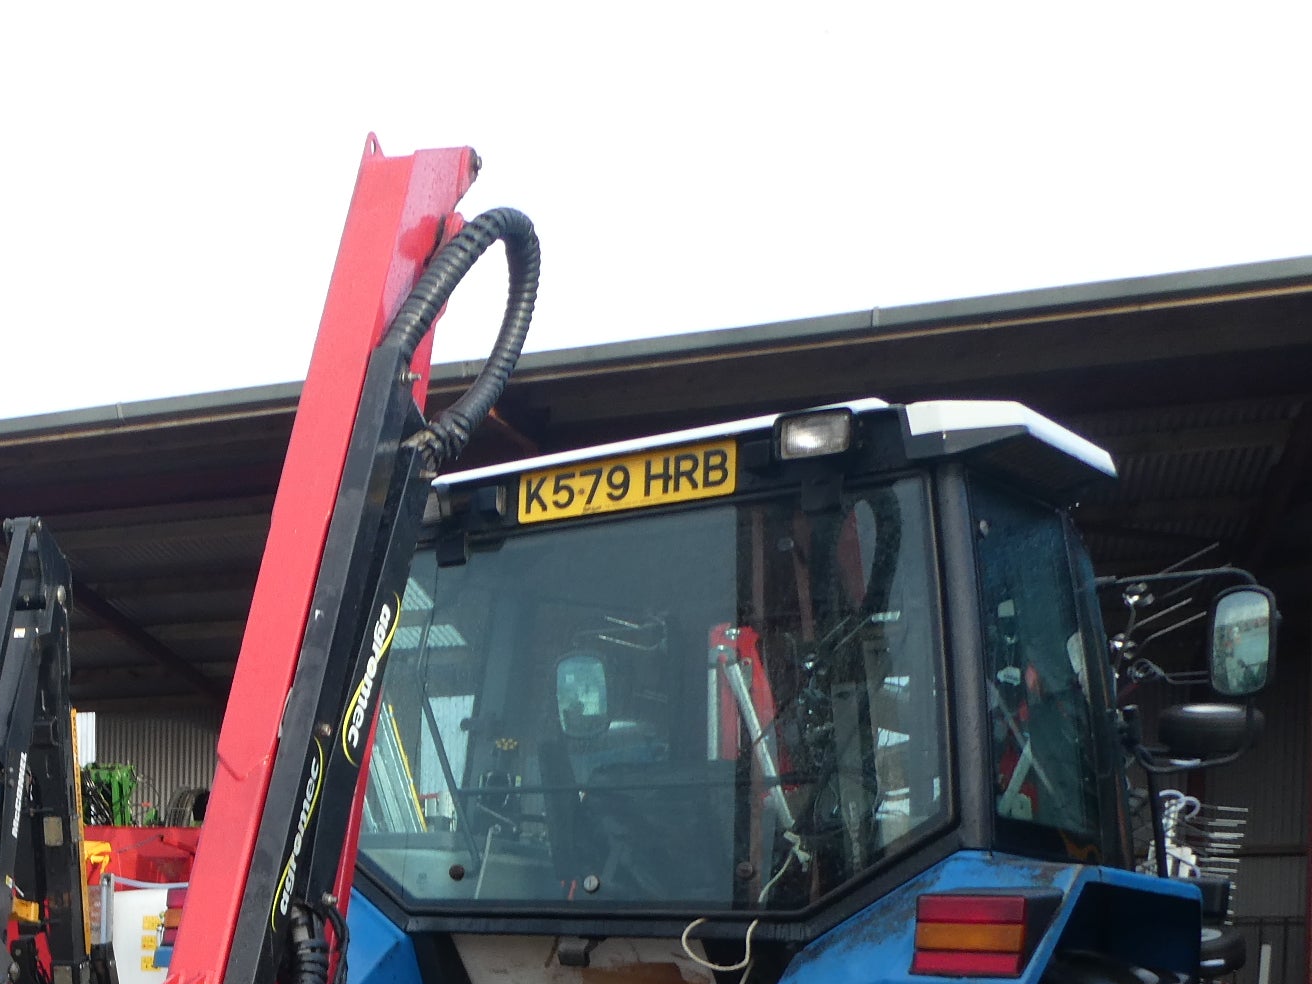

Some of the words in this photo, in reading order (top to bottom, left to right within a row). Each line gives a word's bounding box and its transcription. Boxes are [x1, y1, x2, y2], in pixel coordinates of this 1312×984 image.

[524, 464, 631, 514] K579
[643, 450, 729, 497] HRB
[349, 603, 391, 749] agromec
[279, 756, 319, 916] agromec
